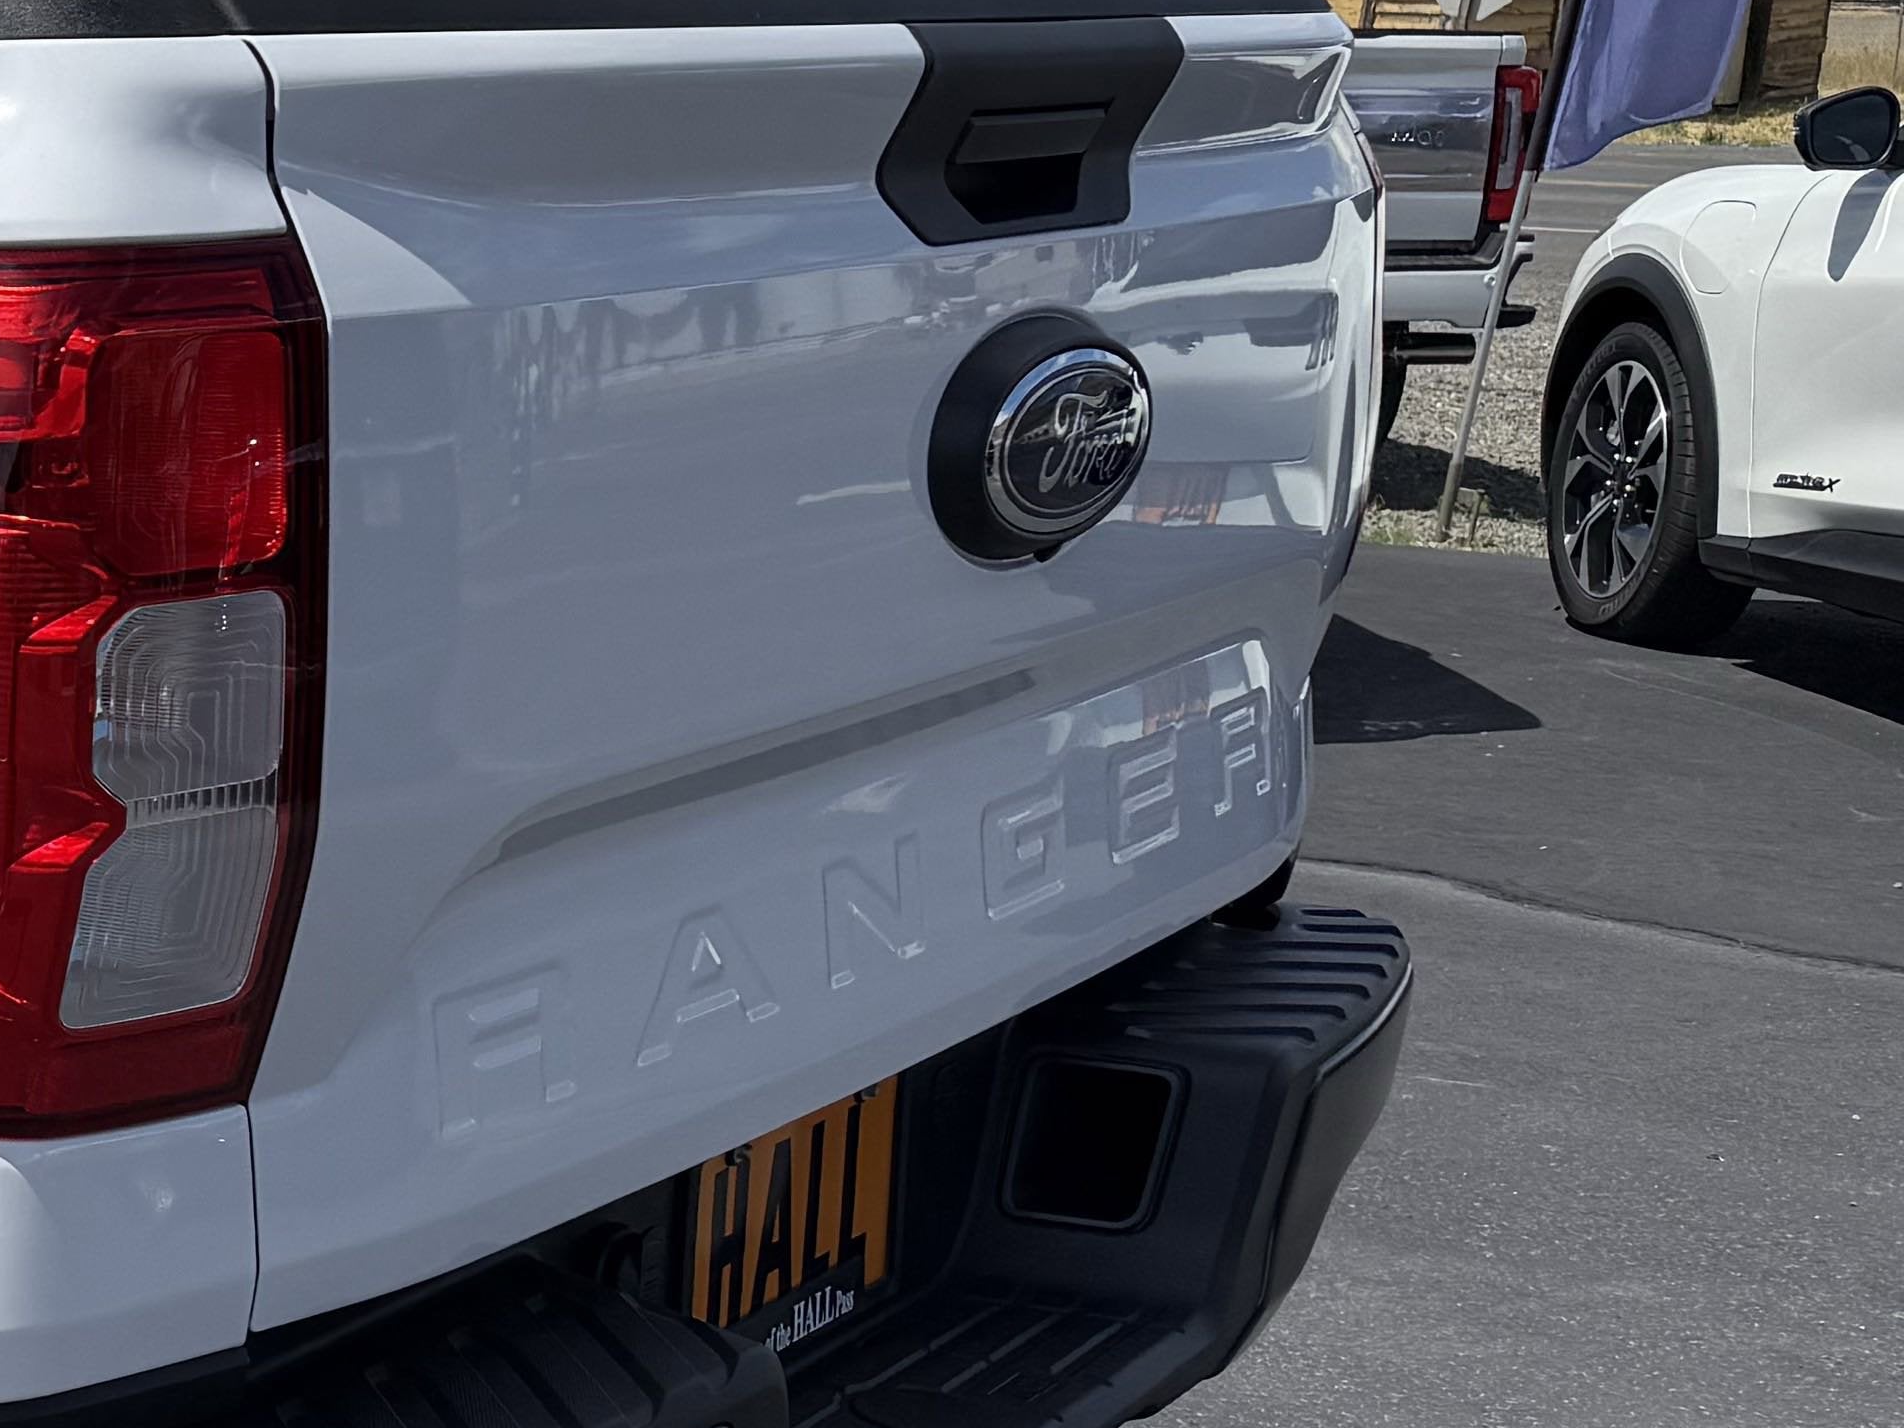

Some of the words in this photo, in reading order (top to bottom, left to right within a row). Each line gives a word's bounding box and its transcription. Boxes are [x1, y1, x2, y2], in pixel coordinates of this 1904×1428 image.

[432, 687, 1276, 1137] RANGER
[706, 1102, 868, 1328] HALL
[792, 1286, 834, 1343] HALL
